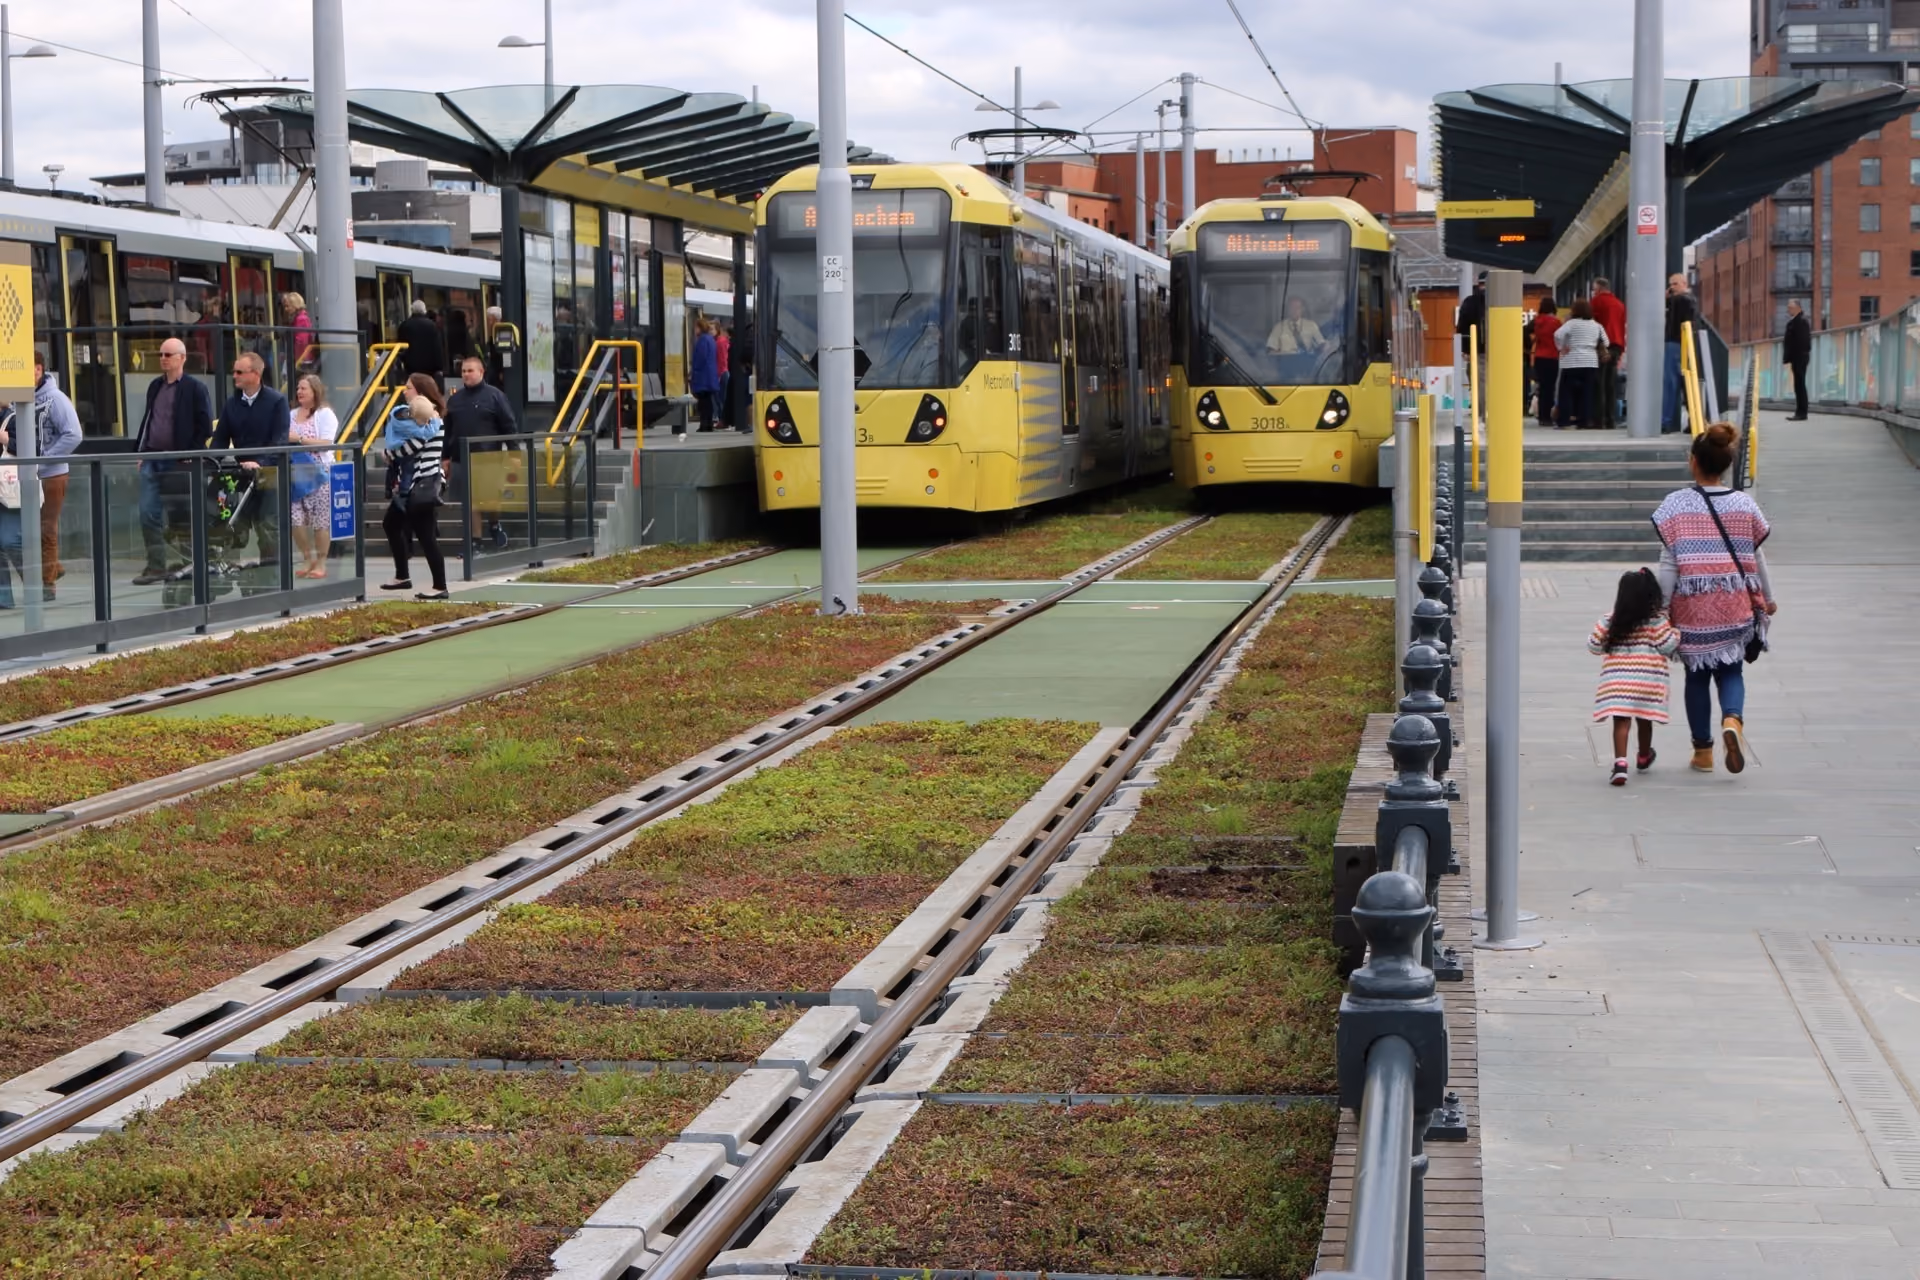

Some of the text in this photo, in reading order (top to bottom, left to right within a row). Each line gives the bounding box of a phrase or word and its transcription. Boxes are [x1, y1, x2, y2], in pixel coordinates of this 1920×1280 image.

[804, 205, 915, 227] Ancham
[1226, 233, 1320, 252] Altrincham
[827, 257, 837, 265] CC
[825, 270, 841, 278] 220
[0, 356, 25, 370] etrolink
